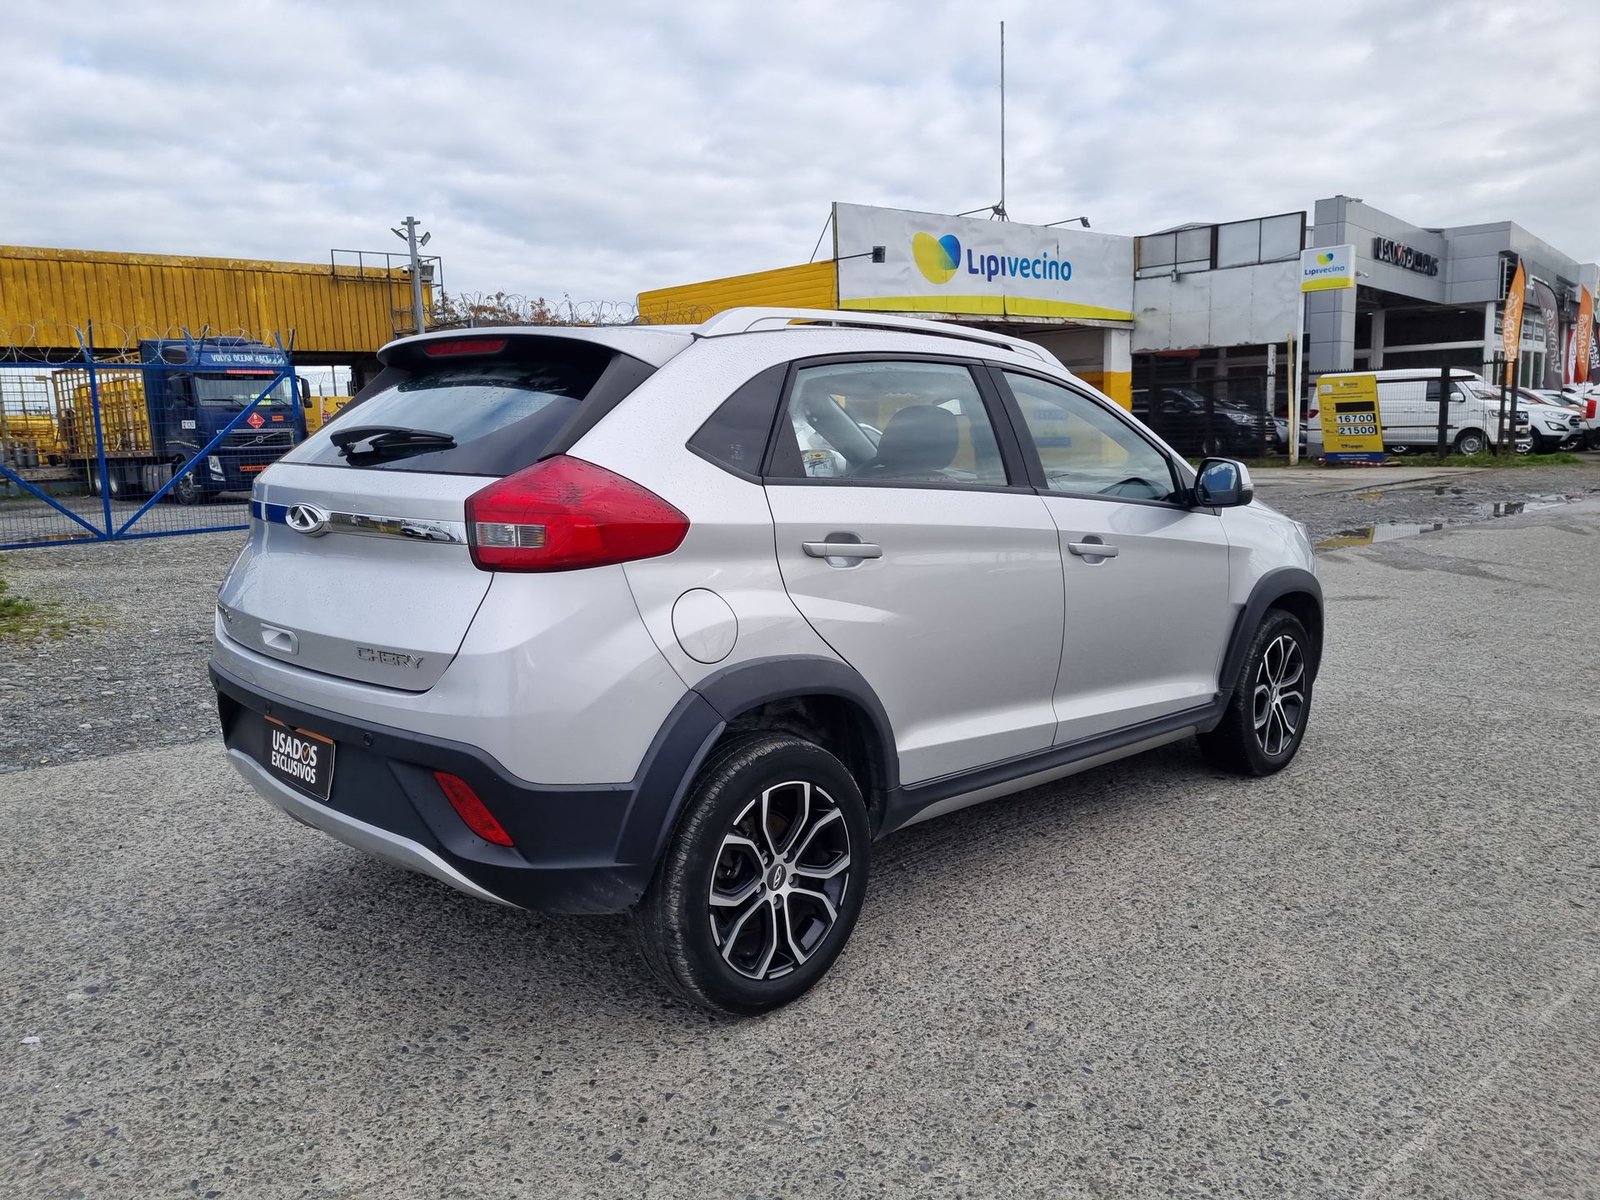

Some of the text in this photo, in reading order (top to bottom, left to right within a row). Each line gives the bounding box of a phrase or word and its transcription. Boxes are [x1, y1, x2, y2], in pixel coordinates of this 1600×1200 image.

[210, 354, 232, 362] VOLVO
[1338, 414, 1373, 423] 16700
[1340, 426, 1375, 434] 21500
[356, 647, 425, 669] CHERY
[272, 729, 318, 767] USADOS
[271, 750, 316, 784] EXCLUSIVOS
